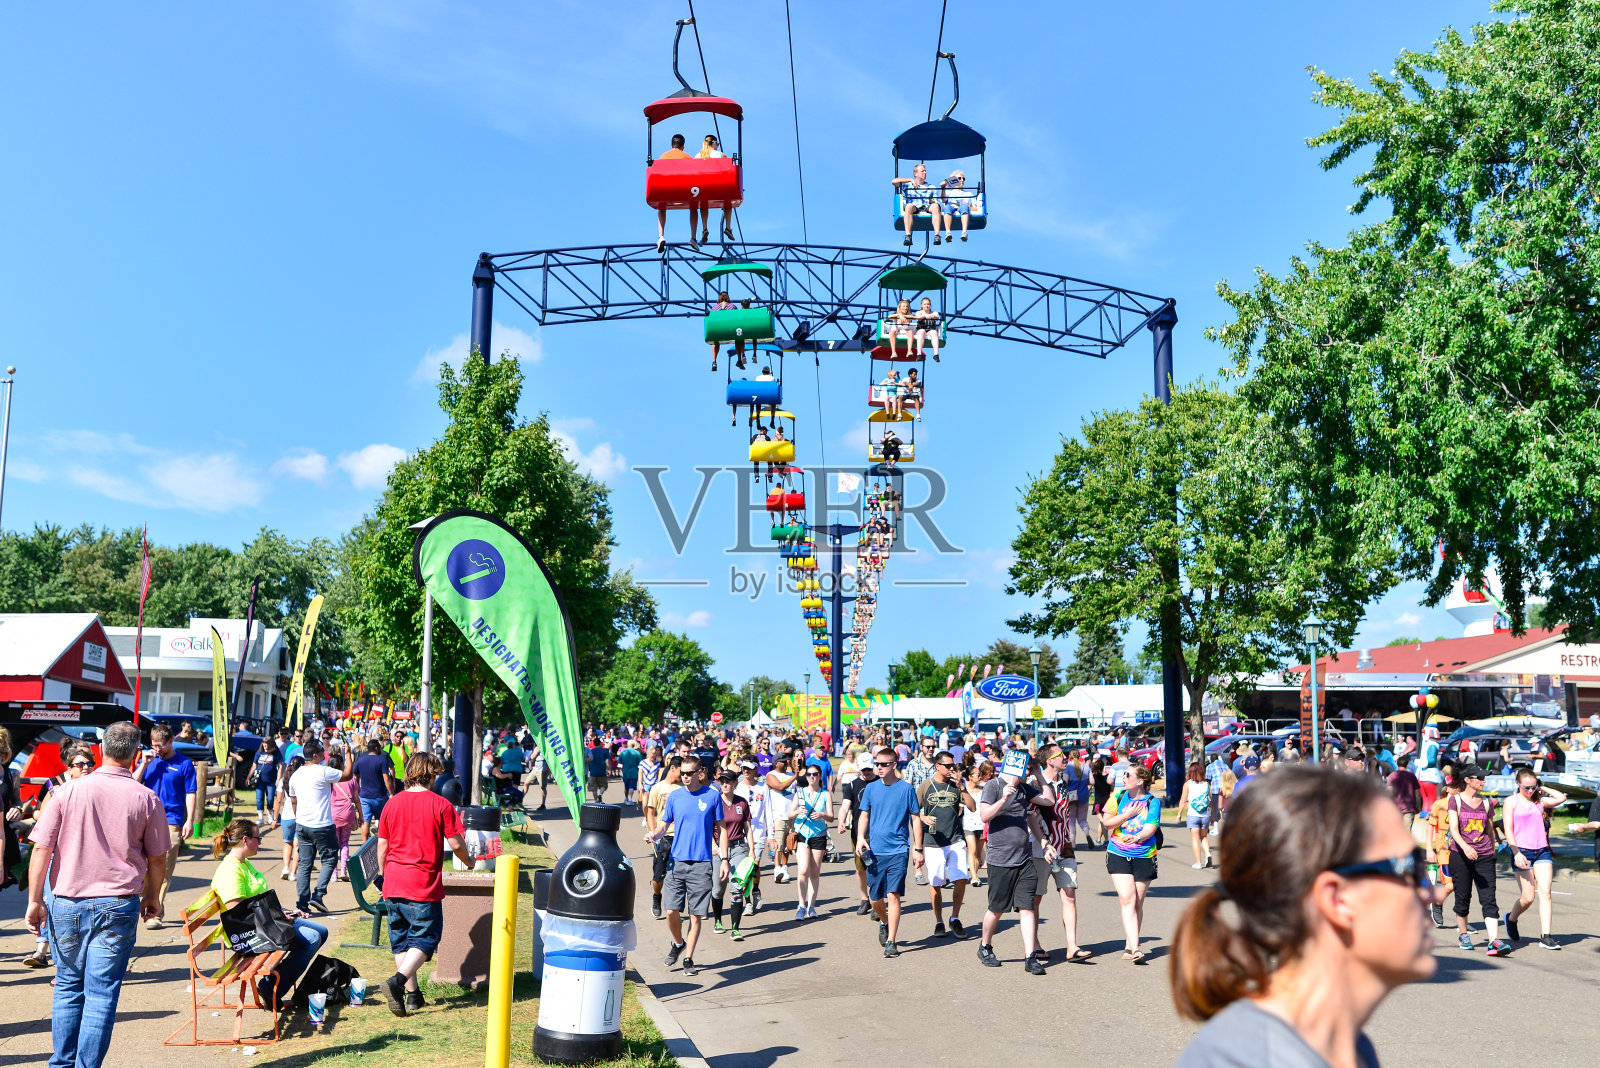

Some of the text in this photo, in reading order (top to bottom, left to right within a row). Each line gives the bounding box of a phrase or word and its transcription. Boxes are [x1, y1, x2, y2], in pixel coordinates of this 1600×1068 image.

[691, 186, 700, 198] 9
[735, 327, 743, 337] 8
[827, 340, 836, 350] 7
[292, 624, 311, 693] LINE
[1560, 654, 1600, 667] RESTR
[991, 679, 1029, 697] Ford
[472, 616, 583, 795] DESIGNATED SMOKING AREA
[1463, 818, 1485, 833] M
[239, 929, 257, 940] BUICK
[232, 936, 262, 951] GMC
